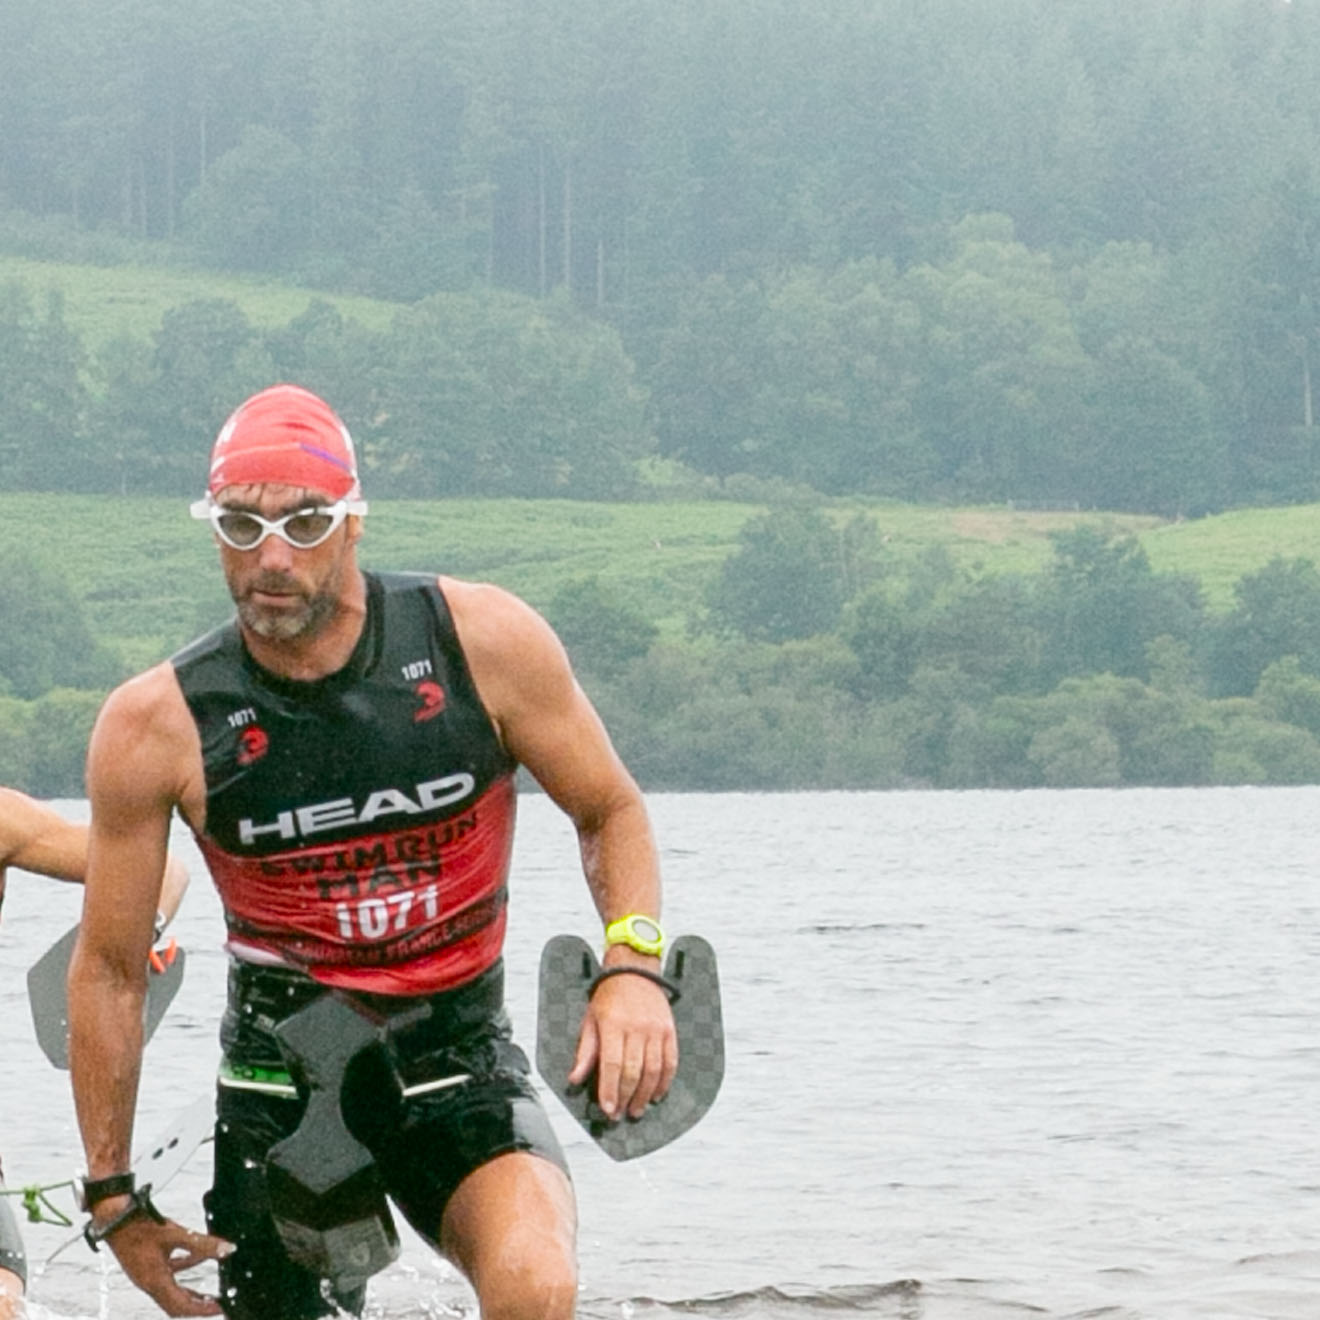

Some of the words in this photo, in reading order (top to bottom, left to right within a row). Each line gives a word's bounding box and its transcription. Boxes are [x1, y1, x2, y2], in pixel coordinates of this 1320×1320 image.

[401, 659, 433, 681] 1071
[227, 707, 257, 727] 1071
[238, 772, 475, 845] HEAD
[335, 884, 440, 939] 1071
